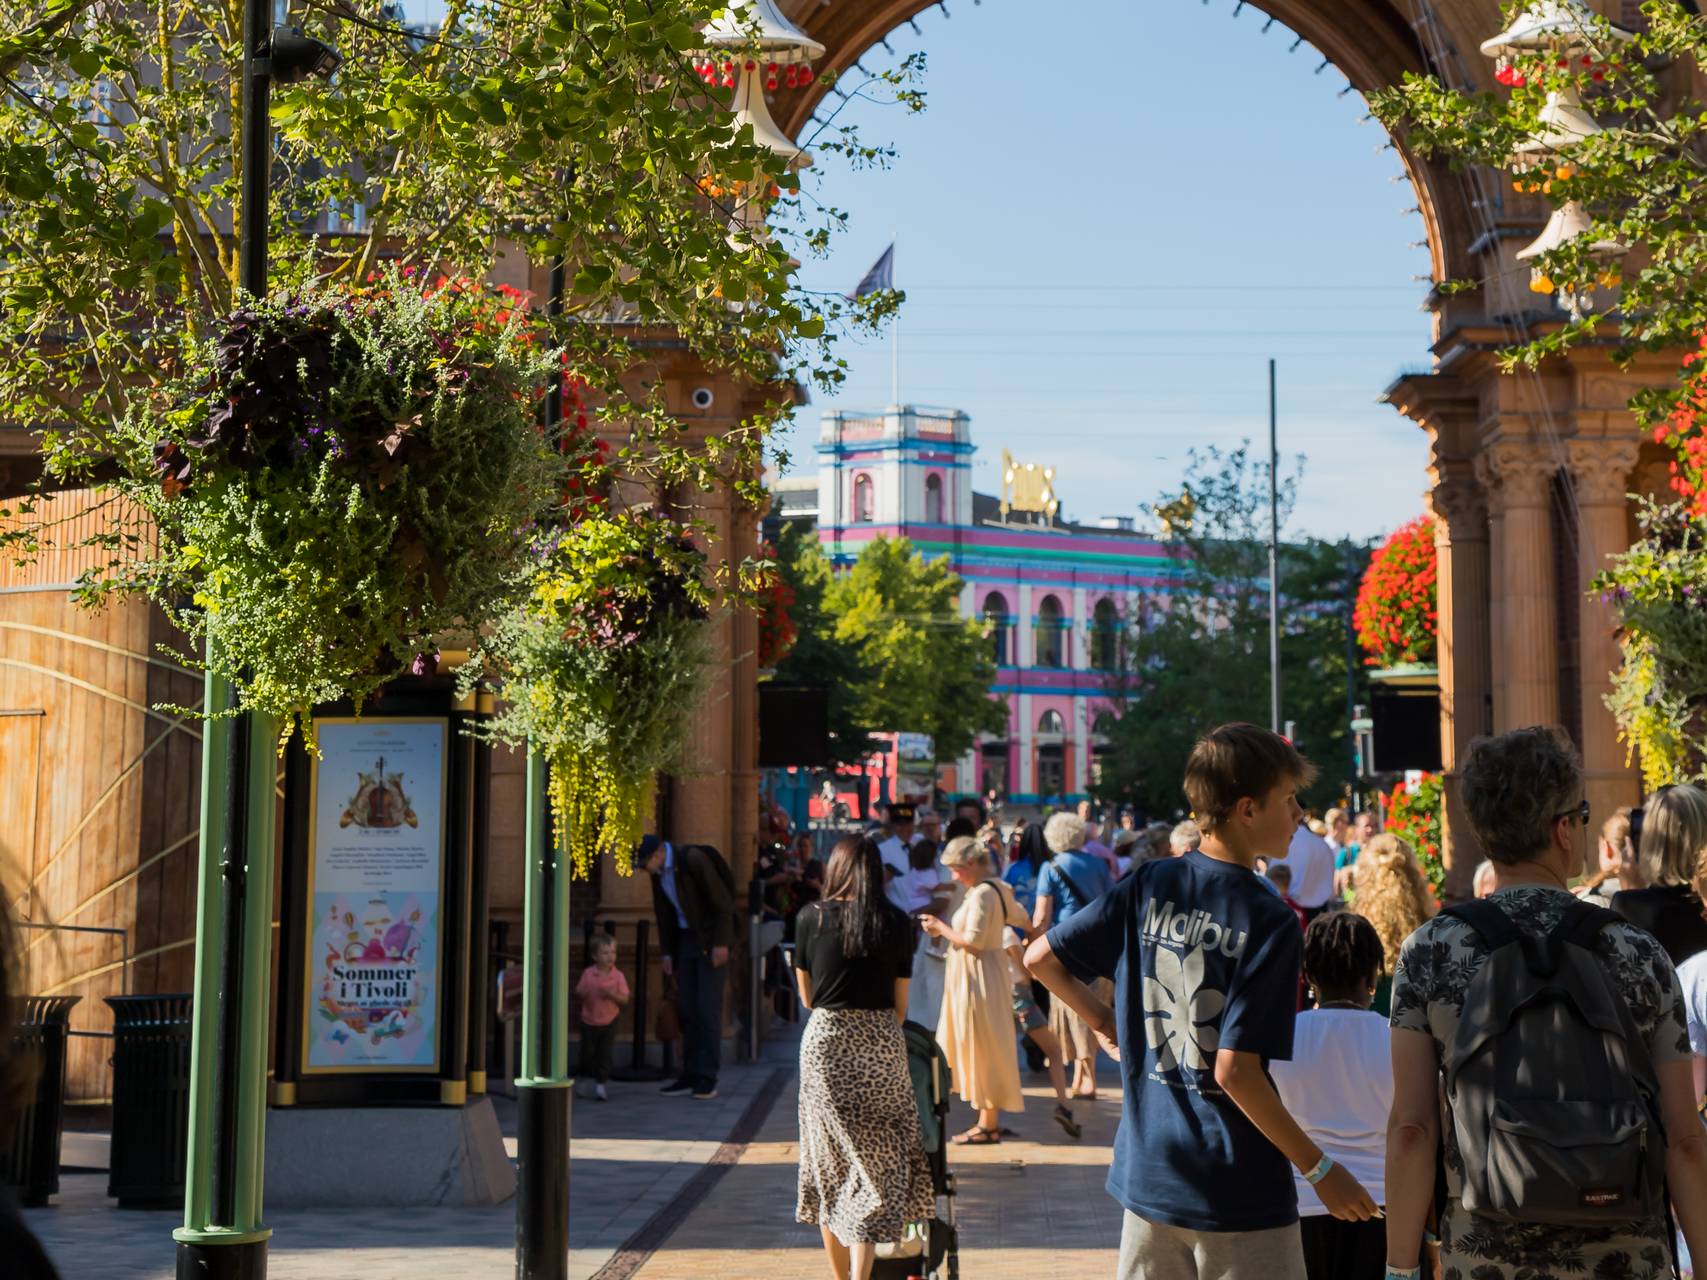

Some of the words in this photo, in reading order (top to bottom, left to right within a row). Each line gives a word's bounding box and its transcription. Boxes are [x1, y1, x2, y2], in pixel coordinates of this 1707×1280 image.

[1143, 897, 1247, 959] Malibu
[333, 966, 416, 981] Sommer
[341, 982, 346, 998] i
[351, 982, 407, 998] Tivoli
